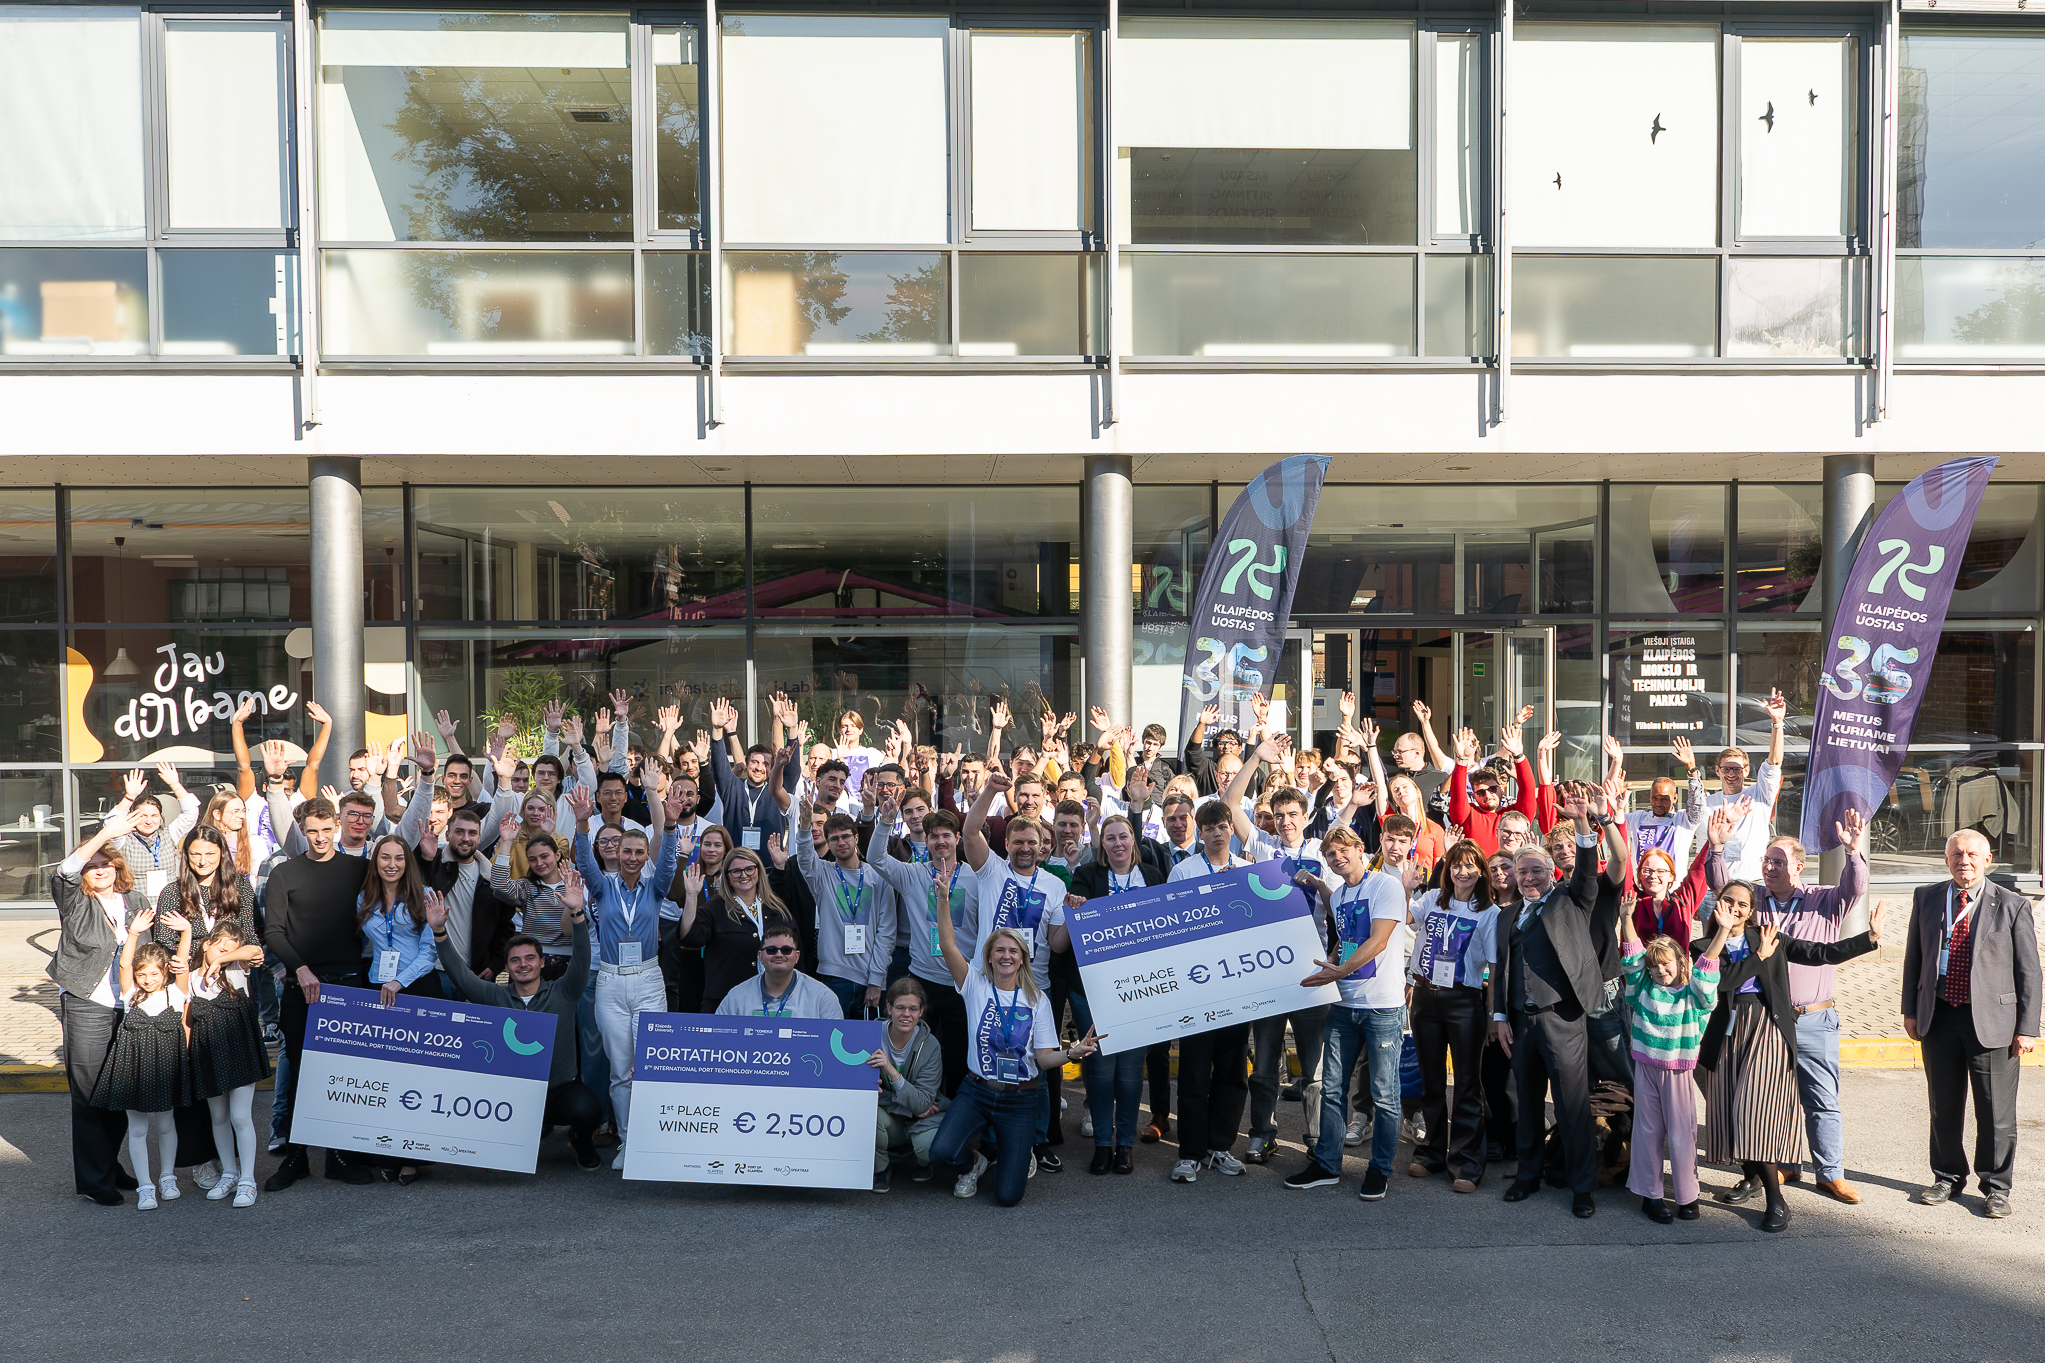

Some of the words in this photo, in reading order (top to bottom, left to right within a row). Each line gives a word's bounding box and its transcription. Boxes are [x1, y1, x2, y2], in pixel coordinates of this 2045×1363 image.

[1213, 603, 1275, 622] KLAIPĖDOS
[1859, 602, 1928, 623] KLAIPĖDOS
[1211, 616, 1256, 632] UOSTAS
[1855, 615, 1904, 632] UOSTAS
[1643, 636, 1669, 646] VIEŠOJI
[1670, 637, 1695, 647] ĮSTAIGA
[1643, 647, 1696, 661] KLAIPĖDOS
[154, 643, 225, 693] Jau
[1641, 664, 1682, 677] MOKSLO
[1686, 664, 1698, 676] IR
[1632, 678, 1706, 693] TECHNOLOGIJŲ
[1649, 693, 1688, 707] PARKAS
[1833, 710, 1883, 726] METUS
[1829, 723, 1897, 743] KURIAME
[1827, 736, 1890, 754] LIETUVAI
[1081, 913, 1180, 945] PORTATHON
[1182, 904, 1221, 923] 2026
[1093, 940, 1136, 953] INTERNATIONAL
[1136, 935, 1151, 944] PORT
[1152, 927, 1189, 939] TECHNOLOGY
[1189, 920, 1224, 931] HACKATHON
[1421, 915, 1438, 975] ORTATHON
[1187, 964, 1211, 984] €
[1217, 945, 1295, 979] 1,500
[1113, 976, 1130, 990] 2nd
[1133, 967, 1176, 985] PLACE
[1118, 980, 1180, 1003] WINNER
[326, 999, 347, 1007] University
[317, 1018, 420, 1044] PORTATHON
[423, 1032, 463, 1049] 2026
[323, 1036, 369, 1048] INTERNATIONAL
[369, 1042, 385, 1050] PORT
[385, 1045, 424, 1055] TECHNOLOGY
[424, 1050, 461, 1060] HACKATHON
[646, 1046, 748, 1064] PORTATHON
[752, 1051, 791, 1065] 2026
[653, 1065, 697, 1073] INTERNATIONAL
[328, 1075, 344, 1085] 3rd
[346, 1077, 390, 1092] PLACE
[326, 1089, 387, 1108] WINNER
[399, 1089, 423, 1111] €
[430, 1093, 513, 1123] 1,000
[659, 1104, 674, 1115] 1st
[677, 1105, 721, 1117] PLACE
[659, 1120, 719, 1134] WINNER
[732, 1111, 756, 1134] €
[765, 1112, 846, 1138] 2,500
